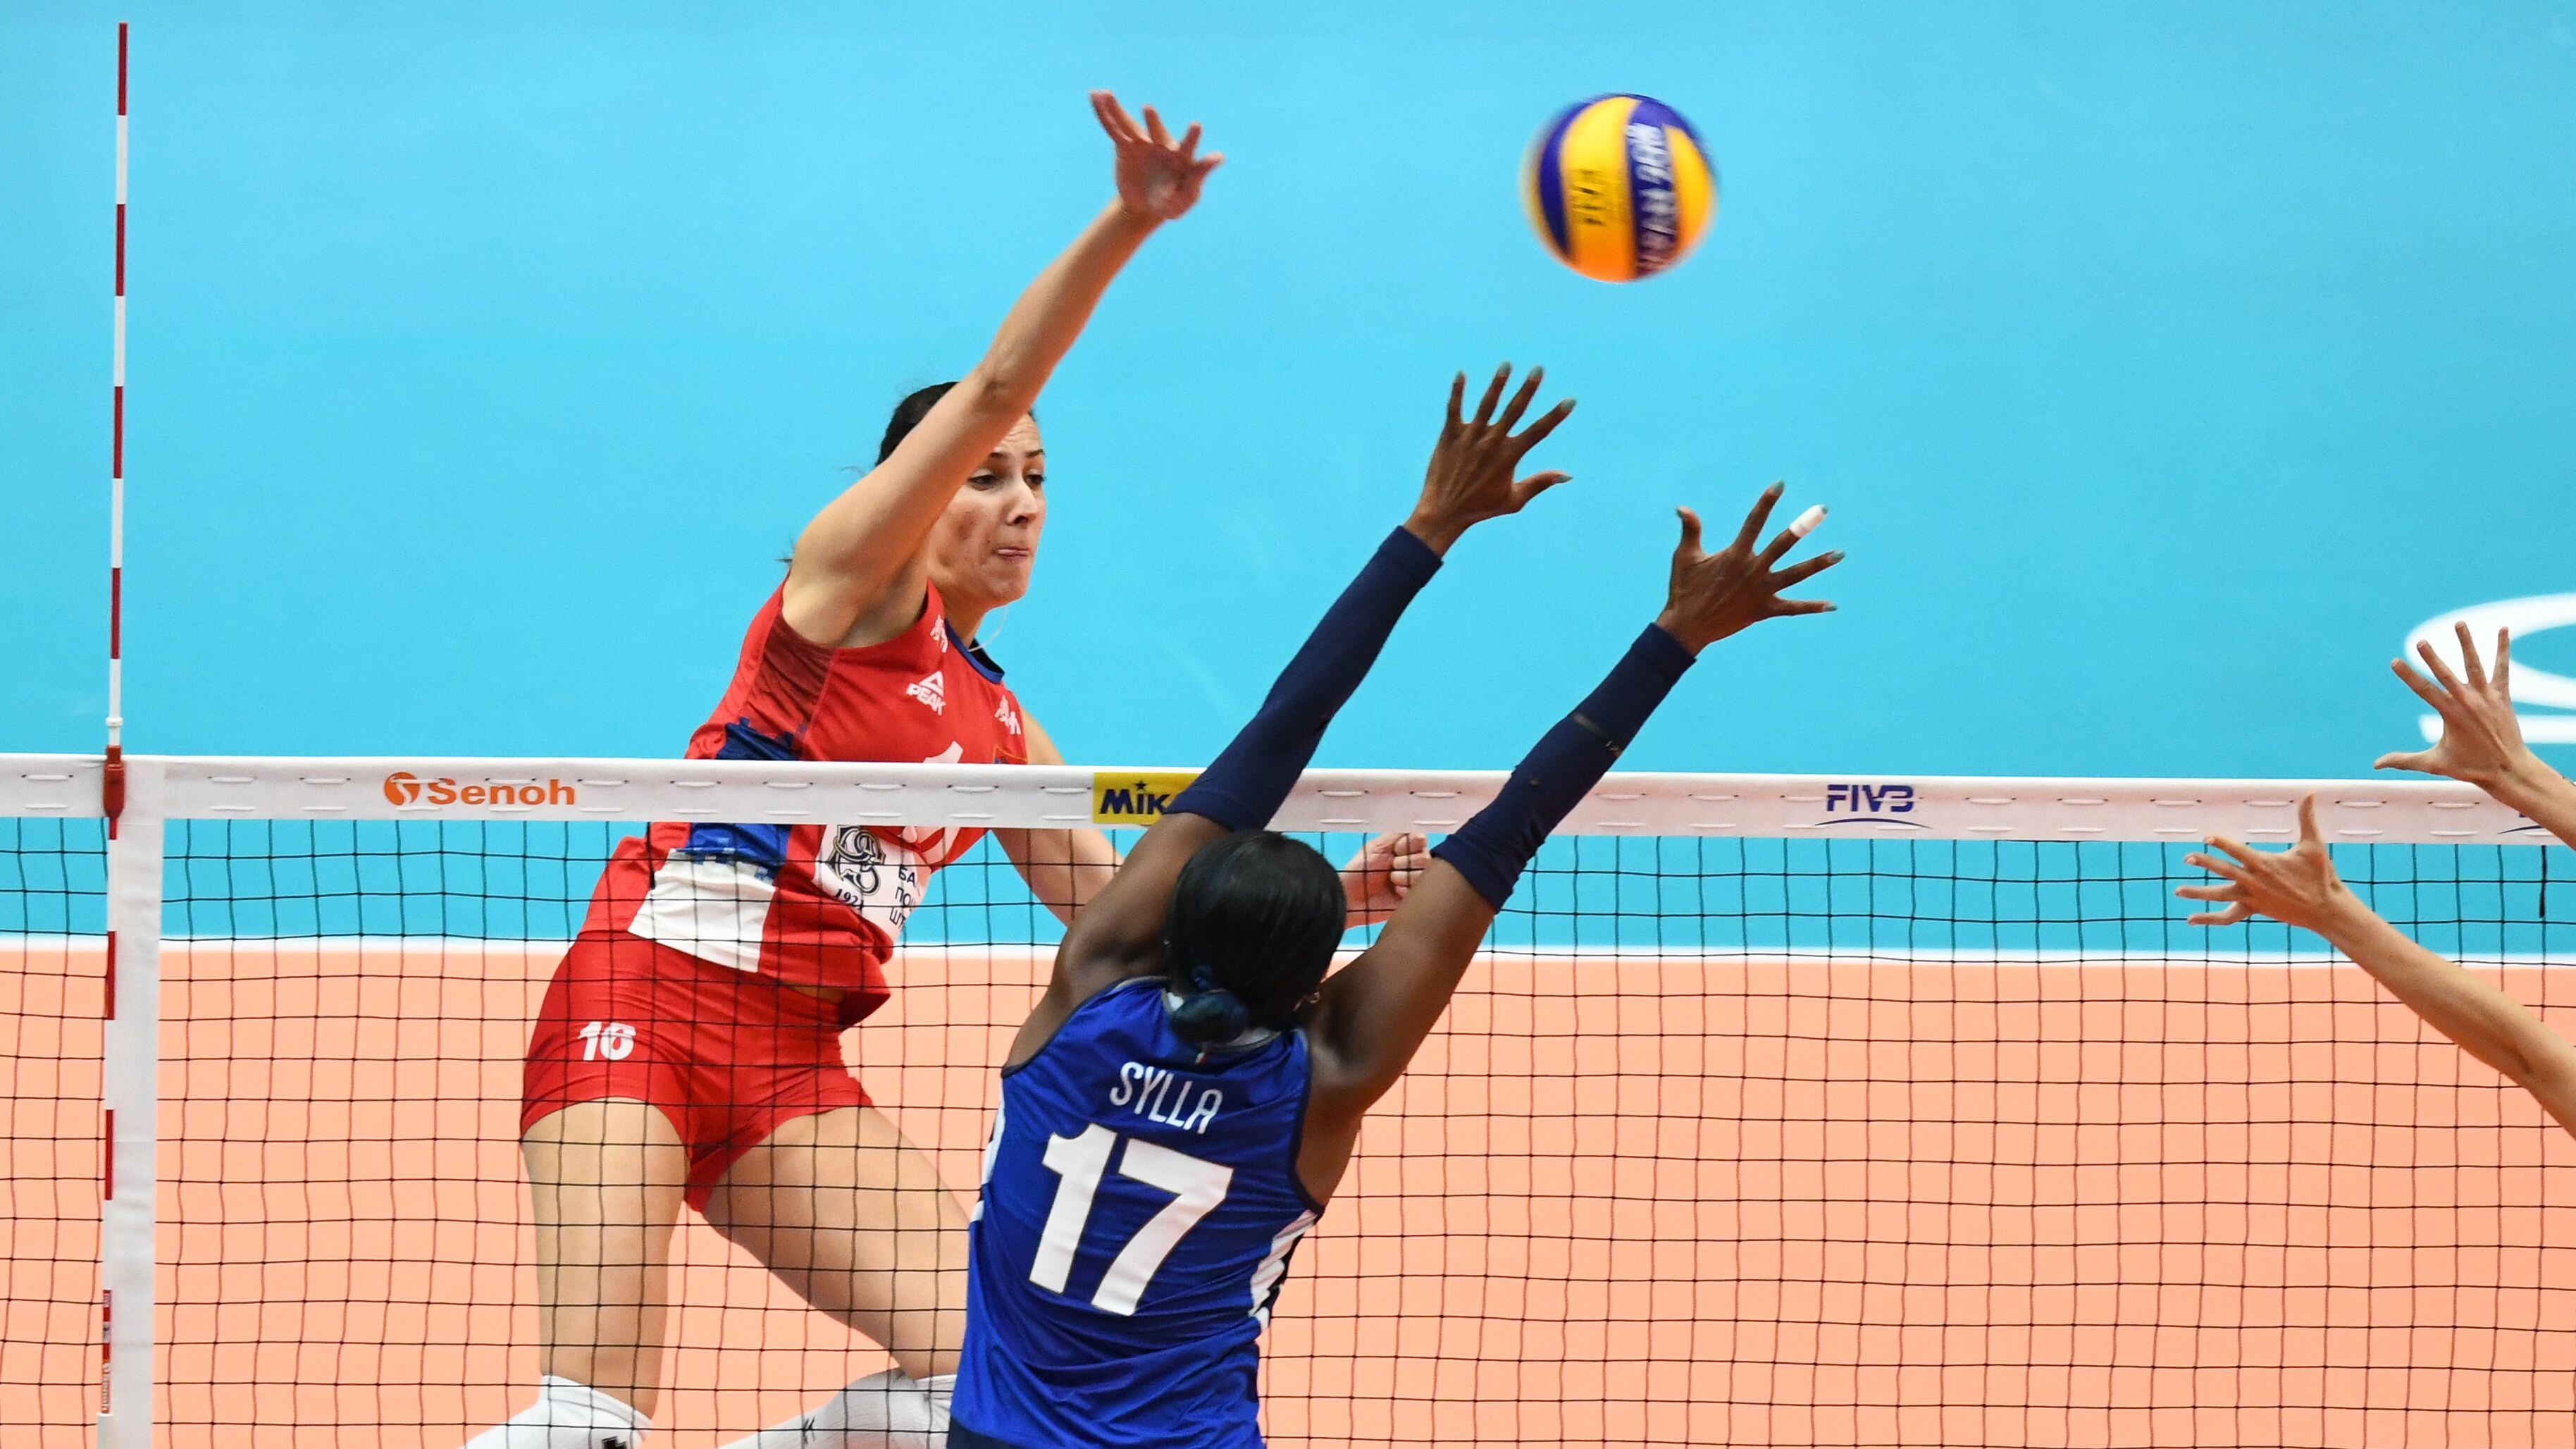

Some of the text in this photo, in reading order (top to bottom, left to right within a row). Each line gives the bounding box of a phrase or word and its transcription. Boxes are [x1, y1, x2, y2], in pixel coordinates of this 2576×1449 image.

[906, 683, 946, 716] PEAK
[427, 777, 576, 805] Senoh
[1826, 784, 1914, 813] FIVB
[895, 886, 913, 911] ПО
[578, 1021, 636, 1061] 16
[1110, 1061, 1224, 1135] SYLLA
[1029, 1122, 1234, 1317] 17
